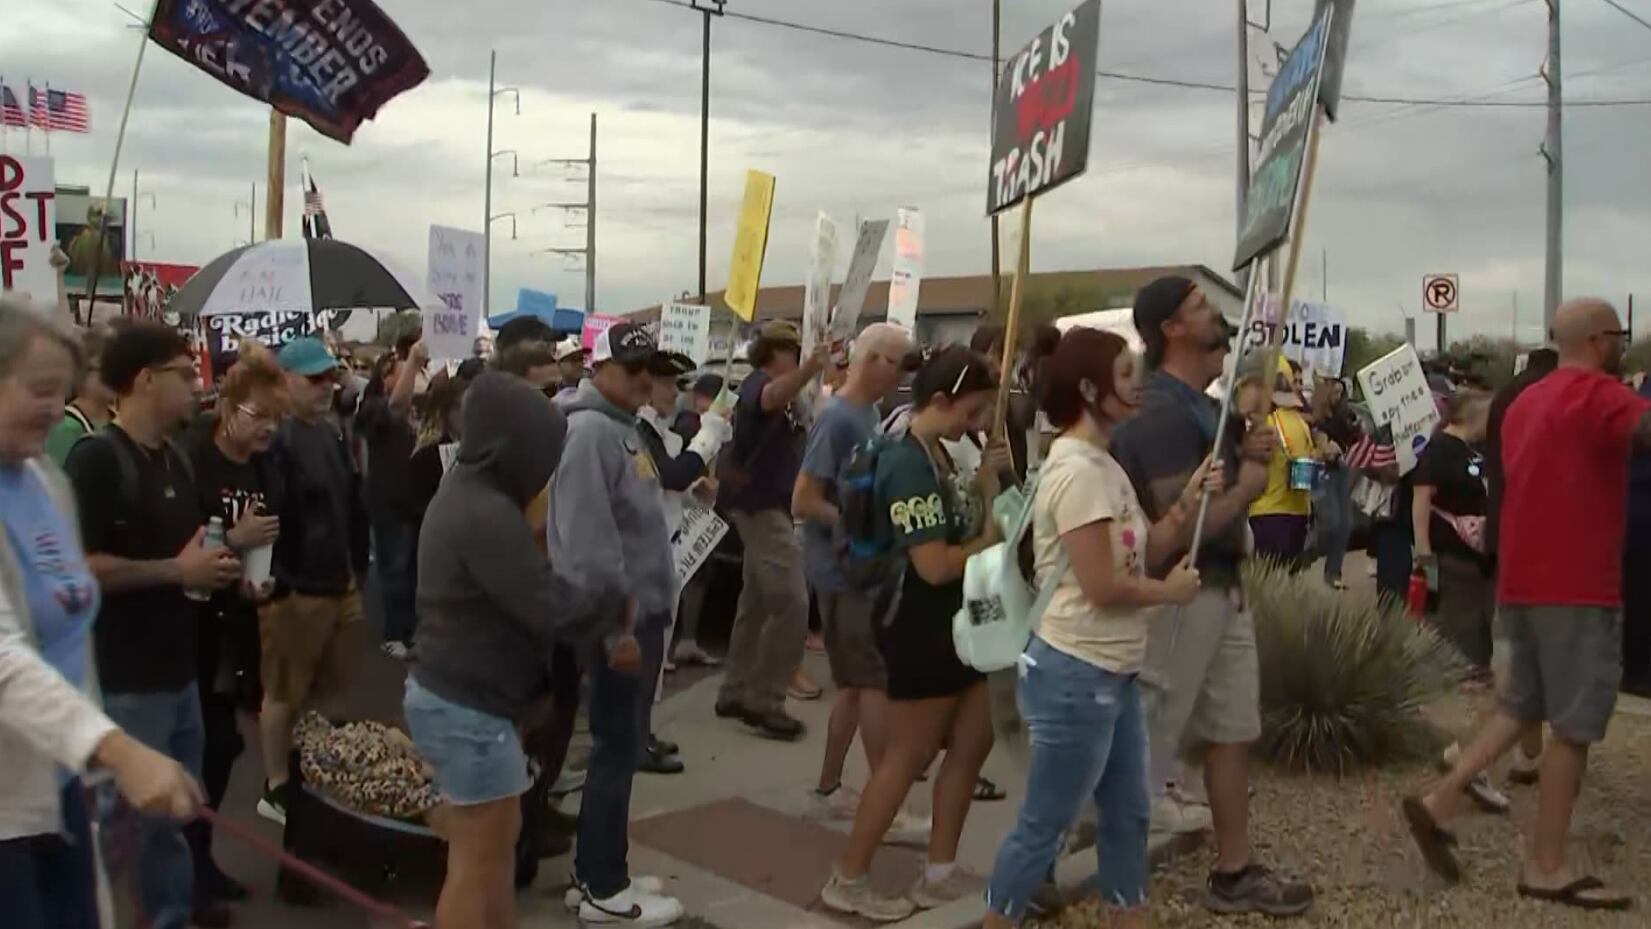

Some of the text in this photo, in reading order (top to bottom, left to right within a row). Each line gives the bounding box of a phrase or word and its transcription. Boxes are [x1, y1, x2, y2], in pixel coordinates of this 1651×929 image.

[1049, 12, 1075, 71] IS
[994, 120, 1065, 208] TRASH
[1250, 320, 1340, 349] STOLEN
